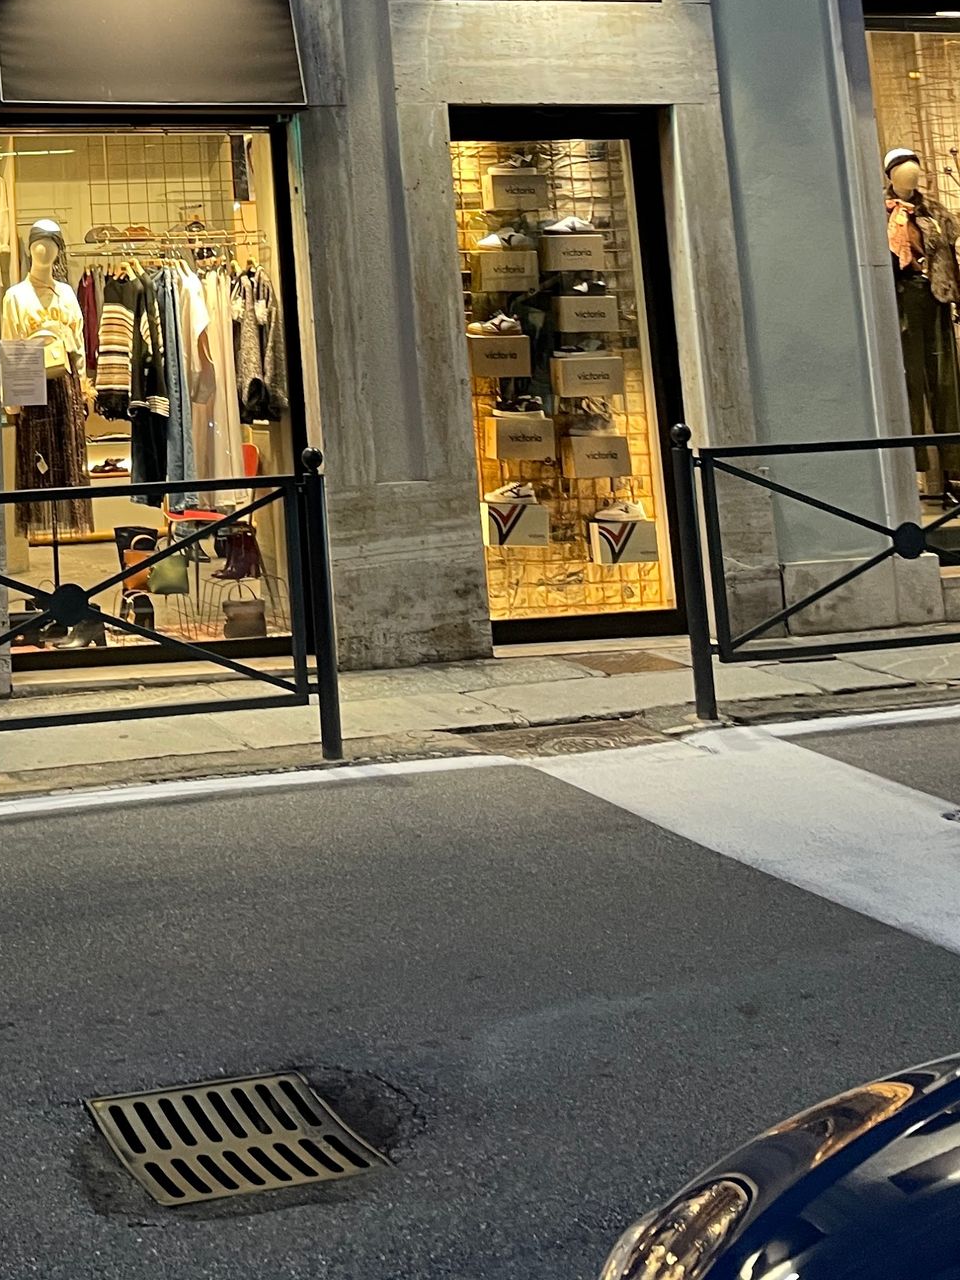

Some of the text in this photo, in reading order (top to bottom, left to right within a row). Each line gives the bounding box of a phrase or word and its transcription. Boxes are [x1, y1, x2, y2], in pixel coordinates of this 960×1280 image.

[504, 184, 536, 195] victoria
[561, 247, 592, 257] victoria
[493, 264, 526, 274] victoria
[574, 310, 606, 319] victoria
[484, 349, 518, 360] victoria
[576, 371, 610, 380] victoria
[508, 431, 542, 443] victoria
[585, 450, 619, 460] victoria
